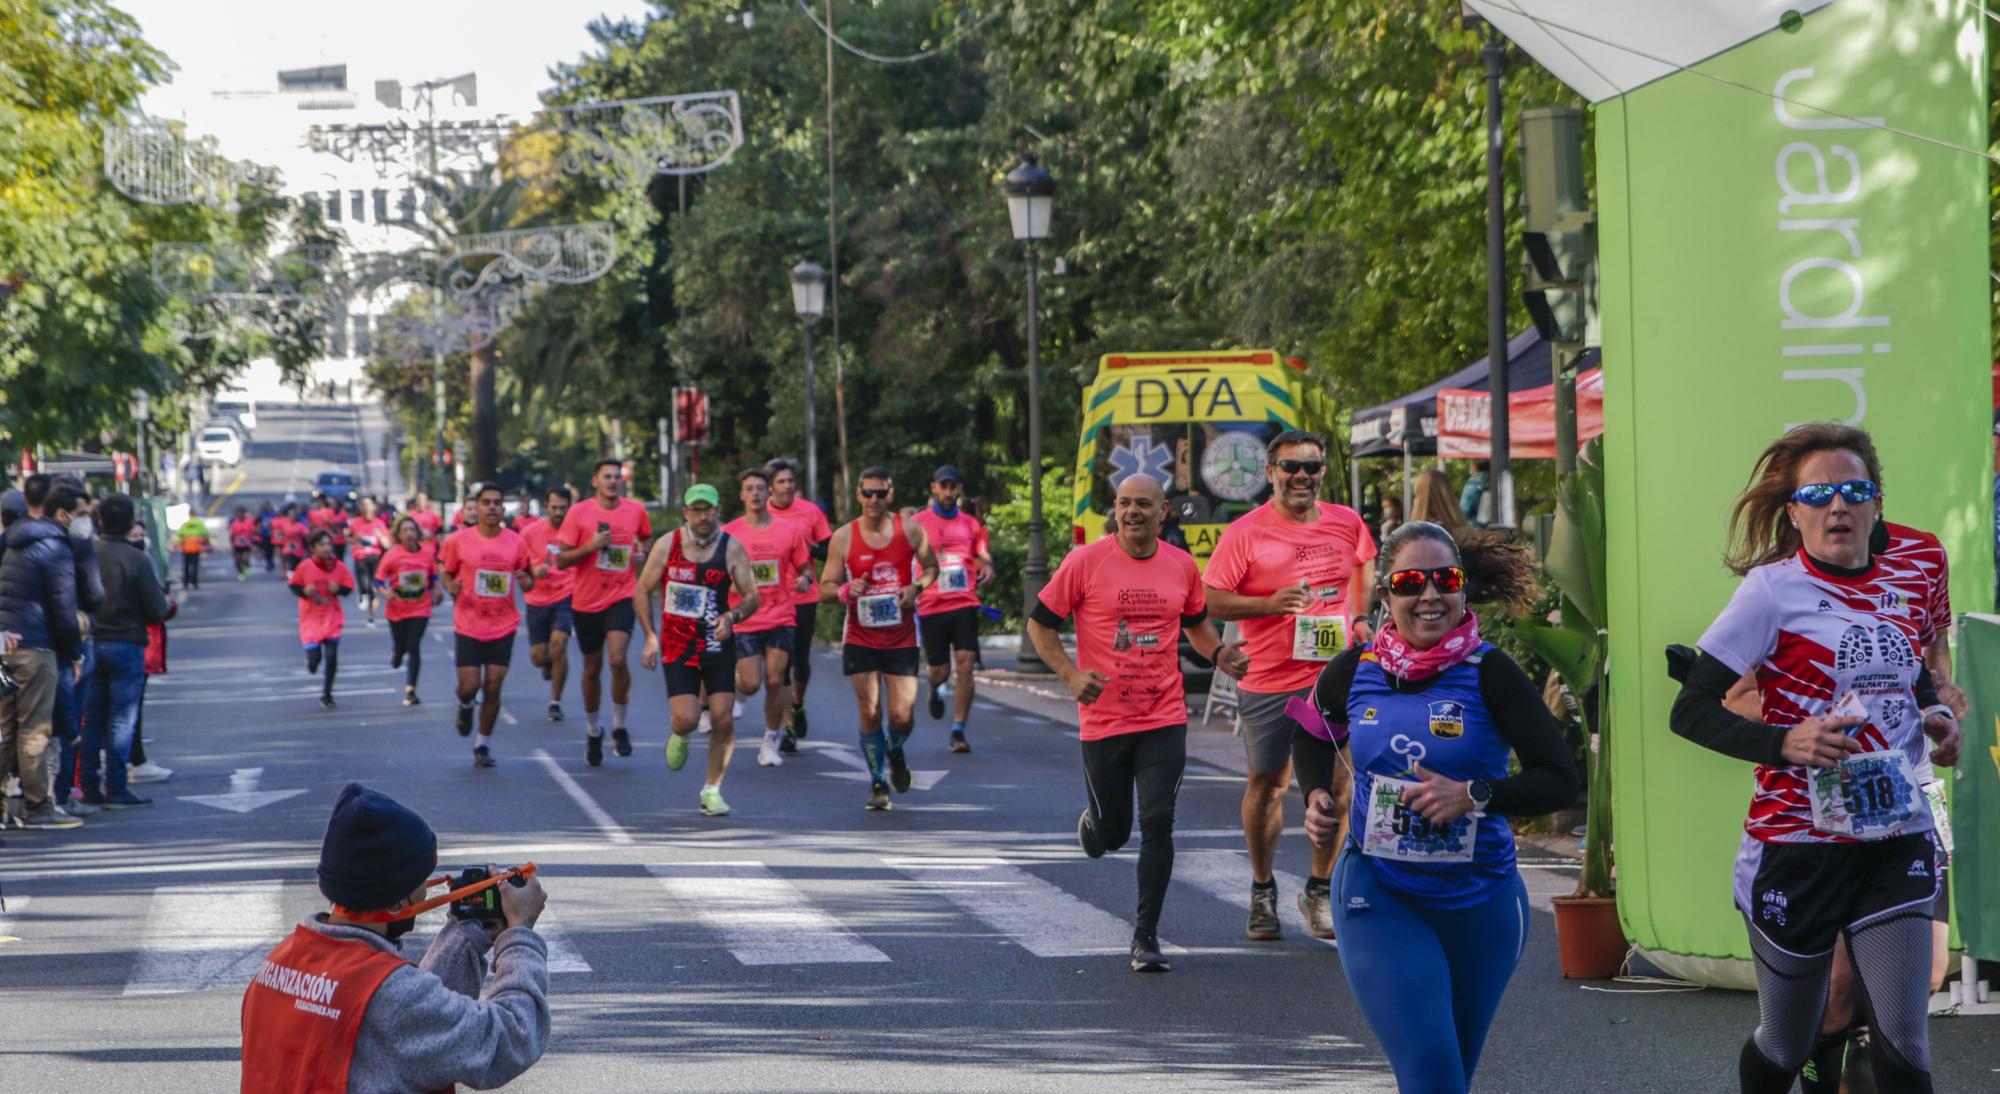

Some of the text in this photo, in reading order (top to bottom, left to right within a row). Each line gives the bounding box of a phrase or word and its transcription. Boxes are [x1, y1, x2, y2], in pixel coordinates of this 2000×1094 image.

[1135, 377, 1243, 418] DYA
[1313, 629, 1336, 647] 101
[1850, 681, 1900, 689] MALPARTIDA
[1853, 673, 1899, 682] ATLETISMO
[1841, 775, 1895, 814] 518
